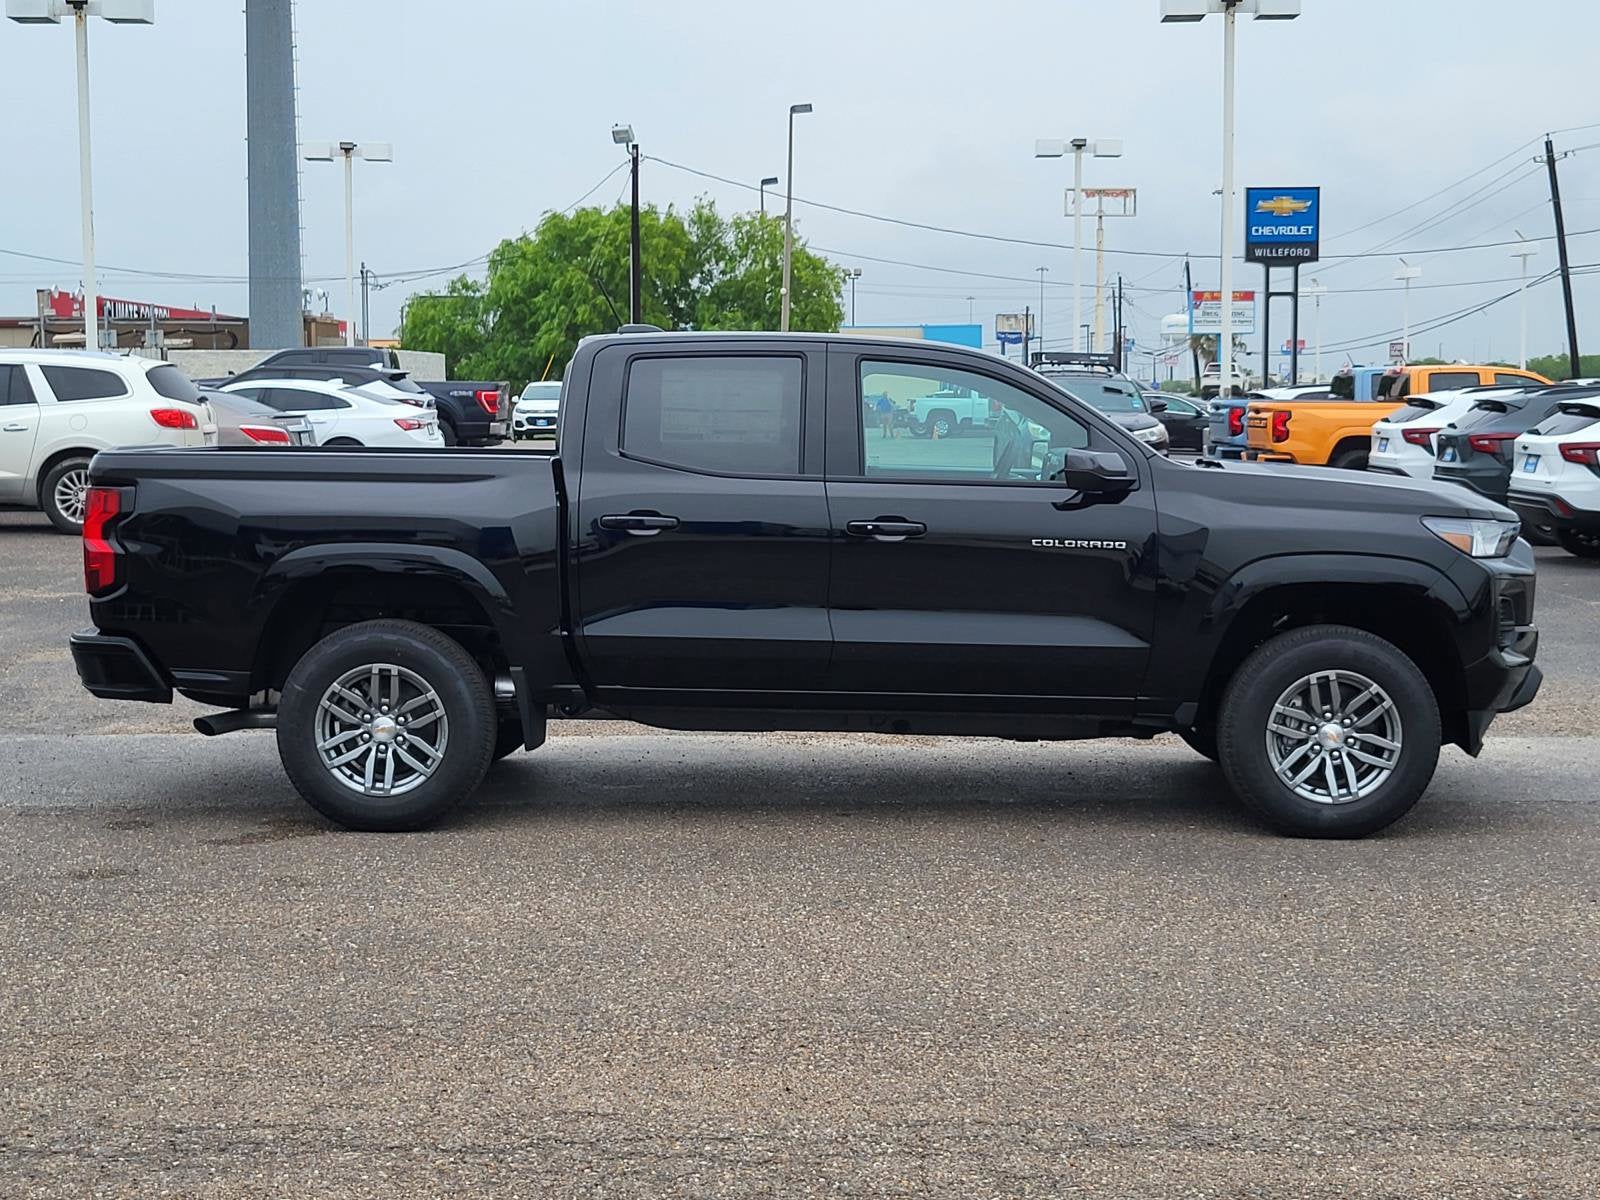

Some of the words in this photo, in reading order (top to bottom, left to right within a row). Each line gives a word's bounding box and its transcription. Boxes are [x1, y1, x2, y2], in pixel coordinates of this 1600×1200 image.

[1251, 225, 1313, 236] CHEVROLET
[1254, 247, 1311, 257] WILLEFORD
[1031, 539, 1126, 549] COLORADO
